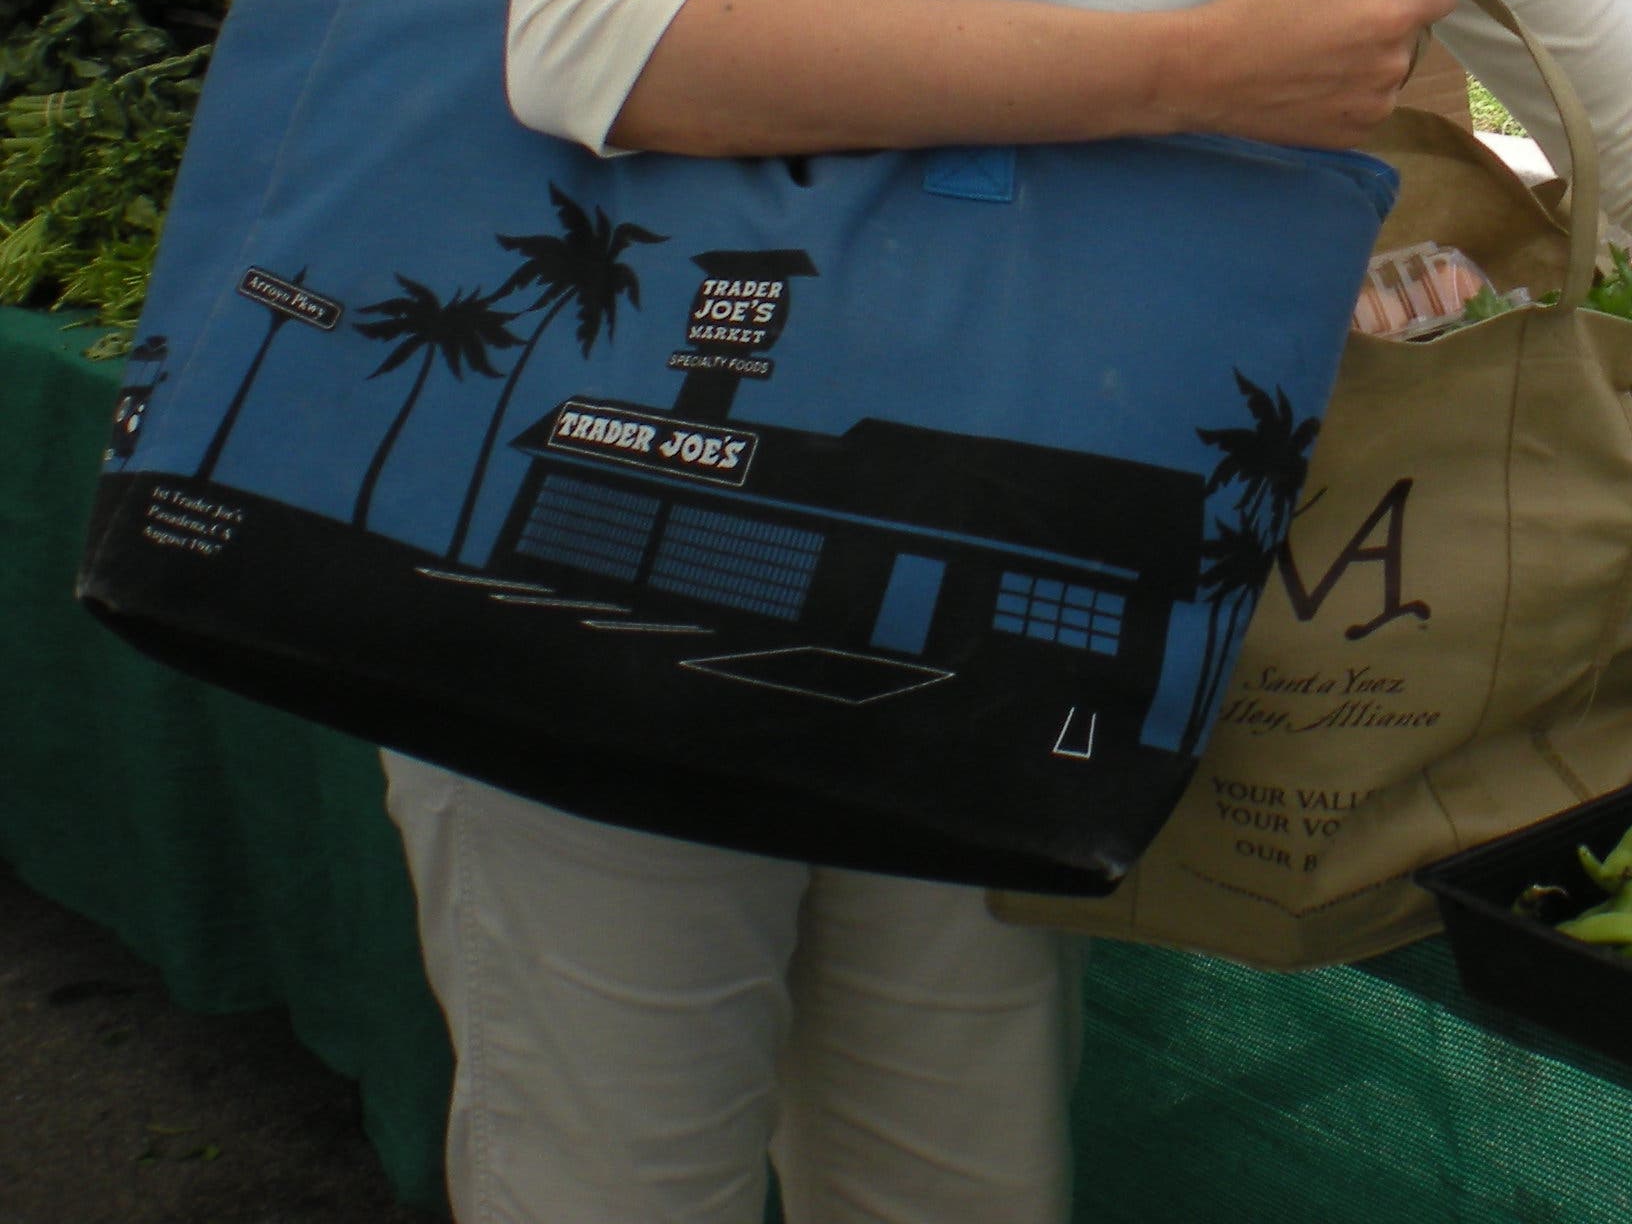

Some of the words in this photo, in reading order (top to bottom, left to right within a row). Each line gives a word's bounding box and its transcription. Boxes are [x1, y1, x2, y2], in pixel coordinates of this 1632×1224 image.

[702, 279, 784, 299] TRADER
[694, 298, 777, 324] JOE'S
[688, 325, 767, 344] MARKET
[668, 354, 728, 369] SPECIALTY
[728, 357, 770, 375] FOODS
[557, 411, 656, 454] TRADER
[658, 430, 748, 470] JOE'S
[1243, 665, 1337, 695] Santa
[1218, 697, 1291, 736] lley
[1287, 699, 1442, 734] Alliance
[1212, 776, 1287, 808] YOUR
[1215, 800, 1290, 833] YOUR
[1235, 839, 1293, 871] OUR
